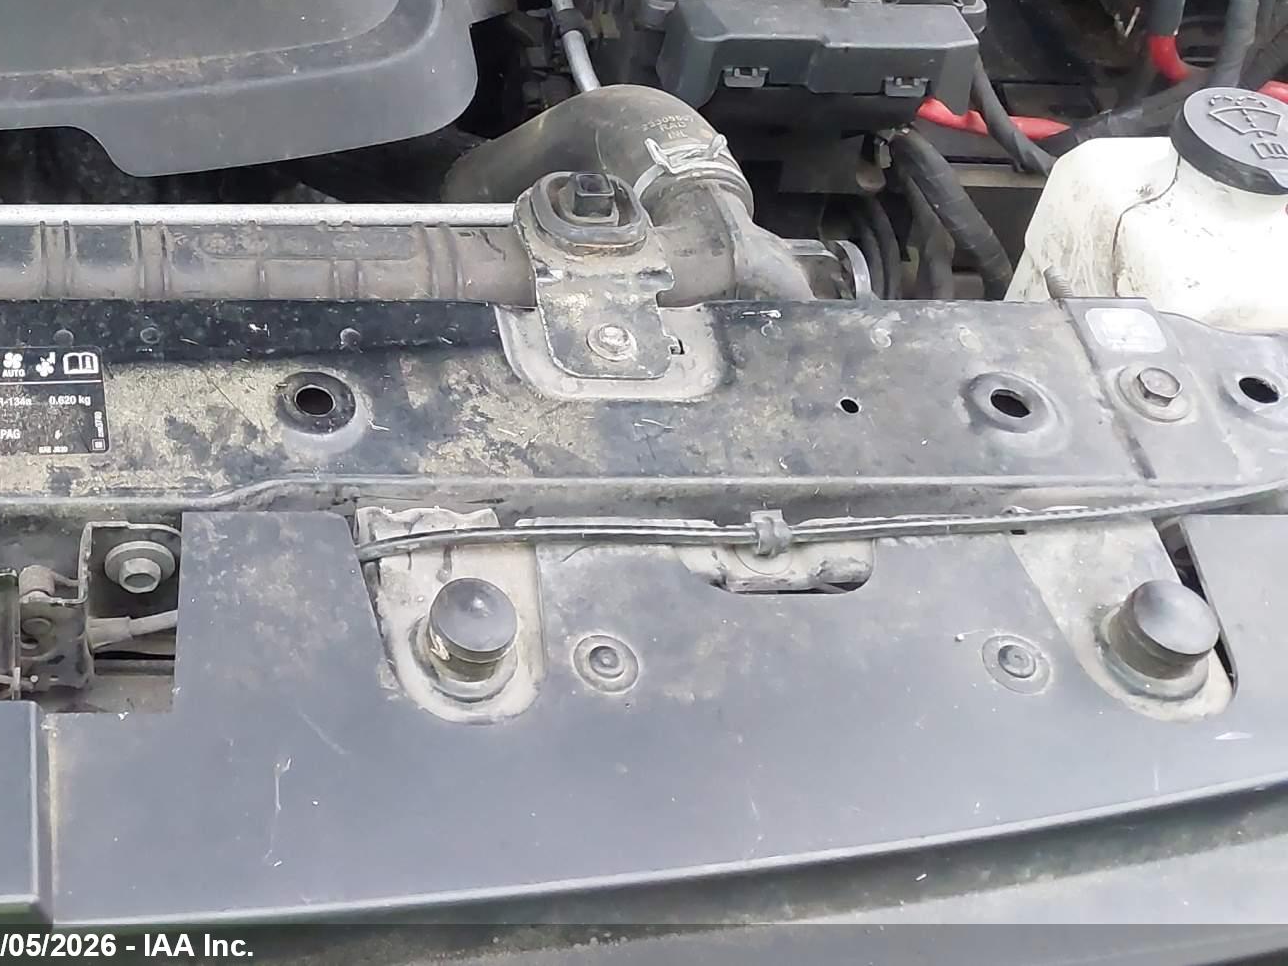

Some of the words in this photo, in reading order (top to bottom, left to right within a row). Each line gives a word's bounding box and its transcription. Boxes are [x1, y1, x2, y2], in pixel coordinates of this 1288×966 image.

[2, 369, 26, 378] AUTO
[48, 395, 77, 405] 0.620
[78, 395, 91, 406] kg
[0, 429, 22, 440] PAG
